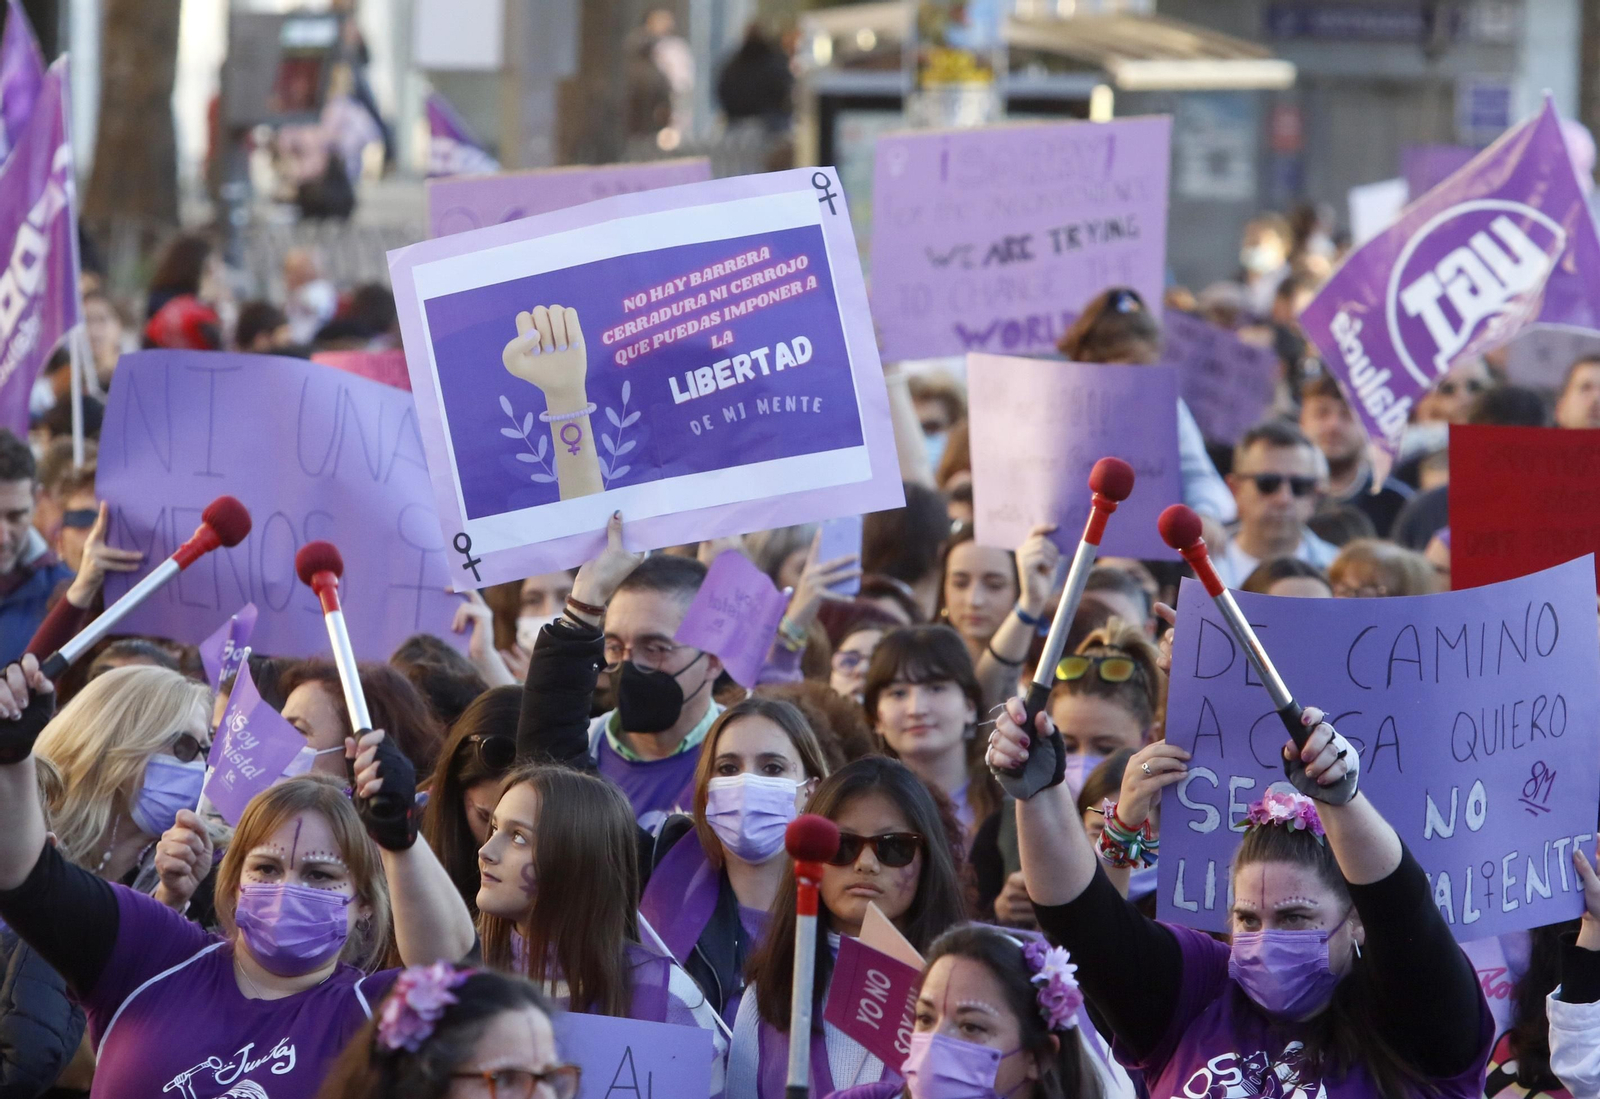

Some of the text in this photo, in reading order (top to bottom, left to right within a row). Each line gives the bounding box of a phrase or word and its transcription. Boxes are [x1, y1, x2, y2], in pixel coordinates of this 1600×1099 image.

[1048, 213, 1140, 255] TRYING
[602, 255, 809, 345] CERRADURA NI CERROJO
[623, 246, 771, 313] NO HAY BARRERA
[615, 275, 818, 366] QUE PUEDAS IMPONER A
[710, 330, 734, 350] LA
[668, 335, 813, 405] LIBERTAD
[122, 362, 430, 485] NI UNA
[689, 395, 823, 436] DE MI MENTE
[1346, 600, 1560, 690] CAMINO
[1191, 692, 1568, 774] A CSA QUIERO
[1423, 777, 1488, 840] NO
[856, 968, 892, 1031] YO NO
